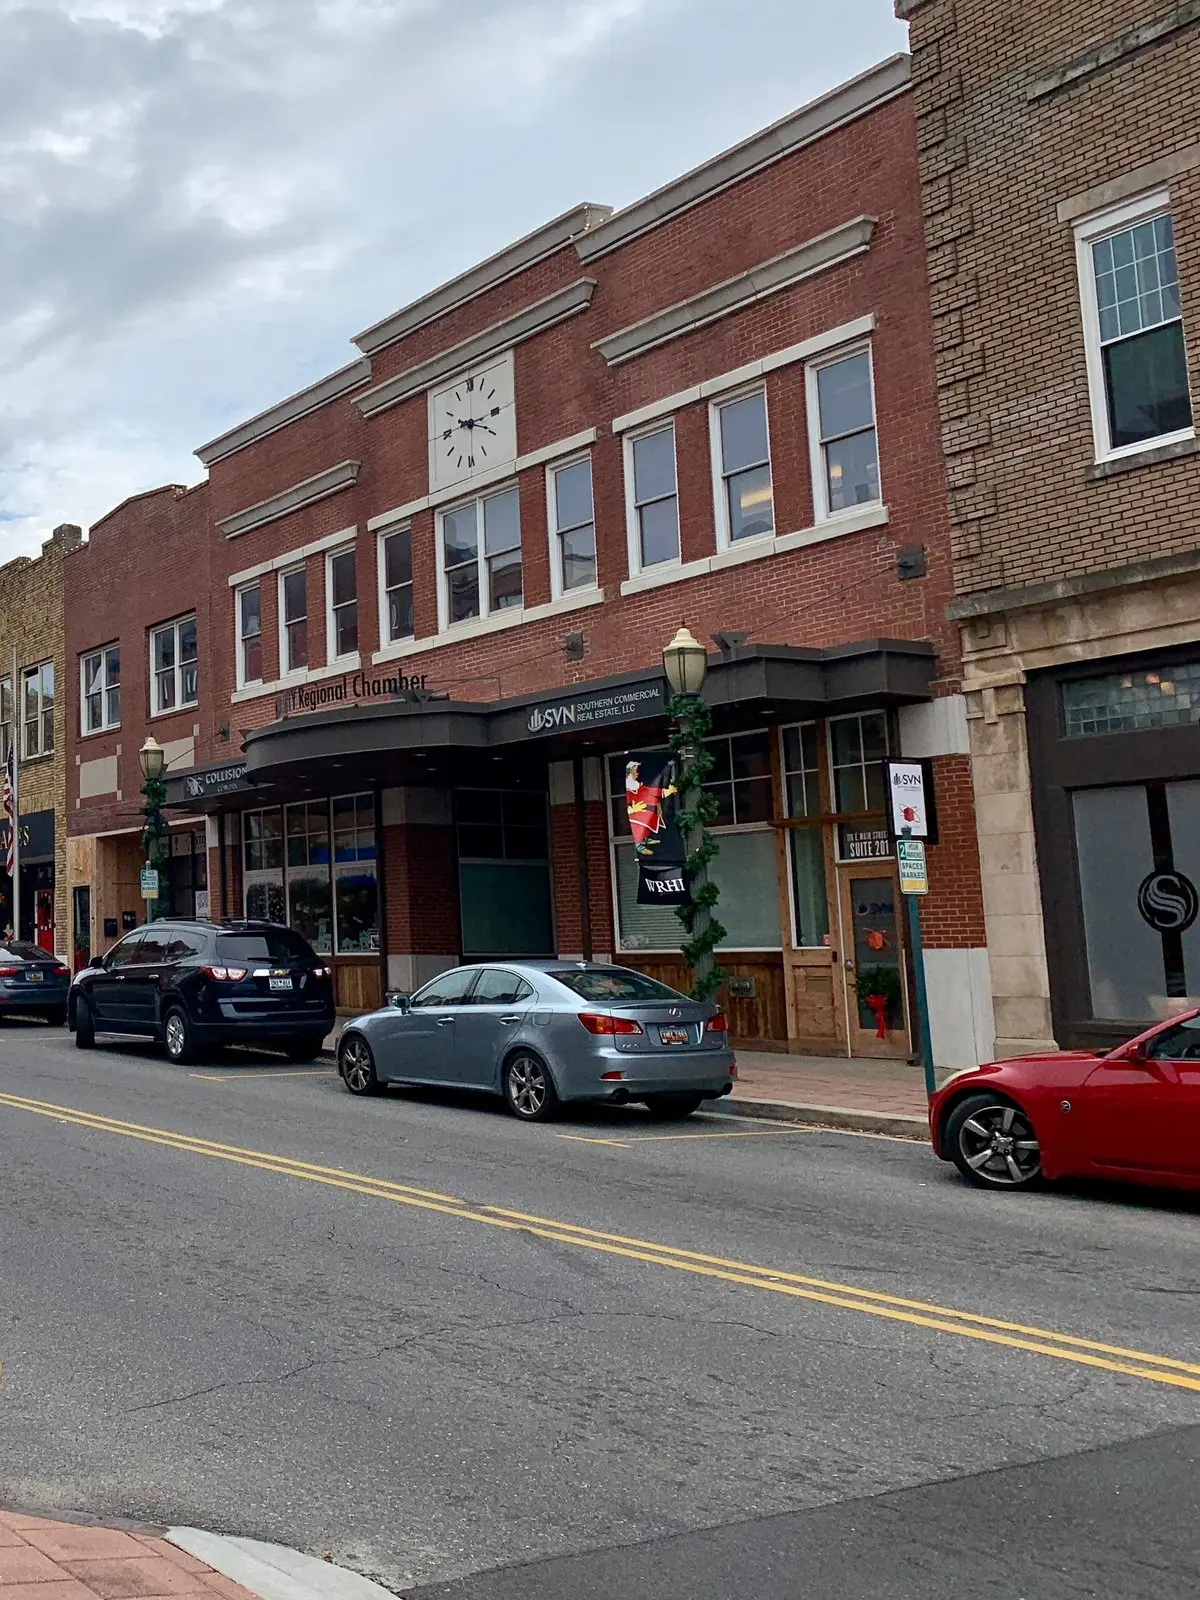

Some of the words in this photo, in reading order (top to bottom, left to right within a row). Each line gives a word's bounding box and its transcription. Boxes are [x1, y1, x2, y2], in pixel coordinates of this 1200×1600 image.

[298, 675, 347, 711] Regional
[352, 667, 428, 698] Chamber
[544, 704, 576, 728] SVN
[576, 698, 614, 712] SOUTHERN
[614, 688, 660, 705] COMMERCIAL
[576, 712, 595, 722] REAL
[622, 703, 636, 714] LLC
[205, 765, 248, 784] COLLISION
[902, 774, 921, 785] SVN
[850, 841, 873, 857] SUITE
[874, 839, 890, 856] 201
[899, 844, 906, 858] 2
[902, 862, 923, 870] SPACES
[644, 878, 686, 893] WRHI
